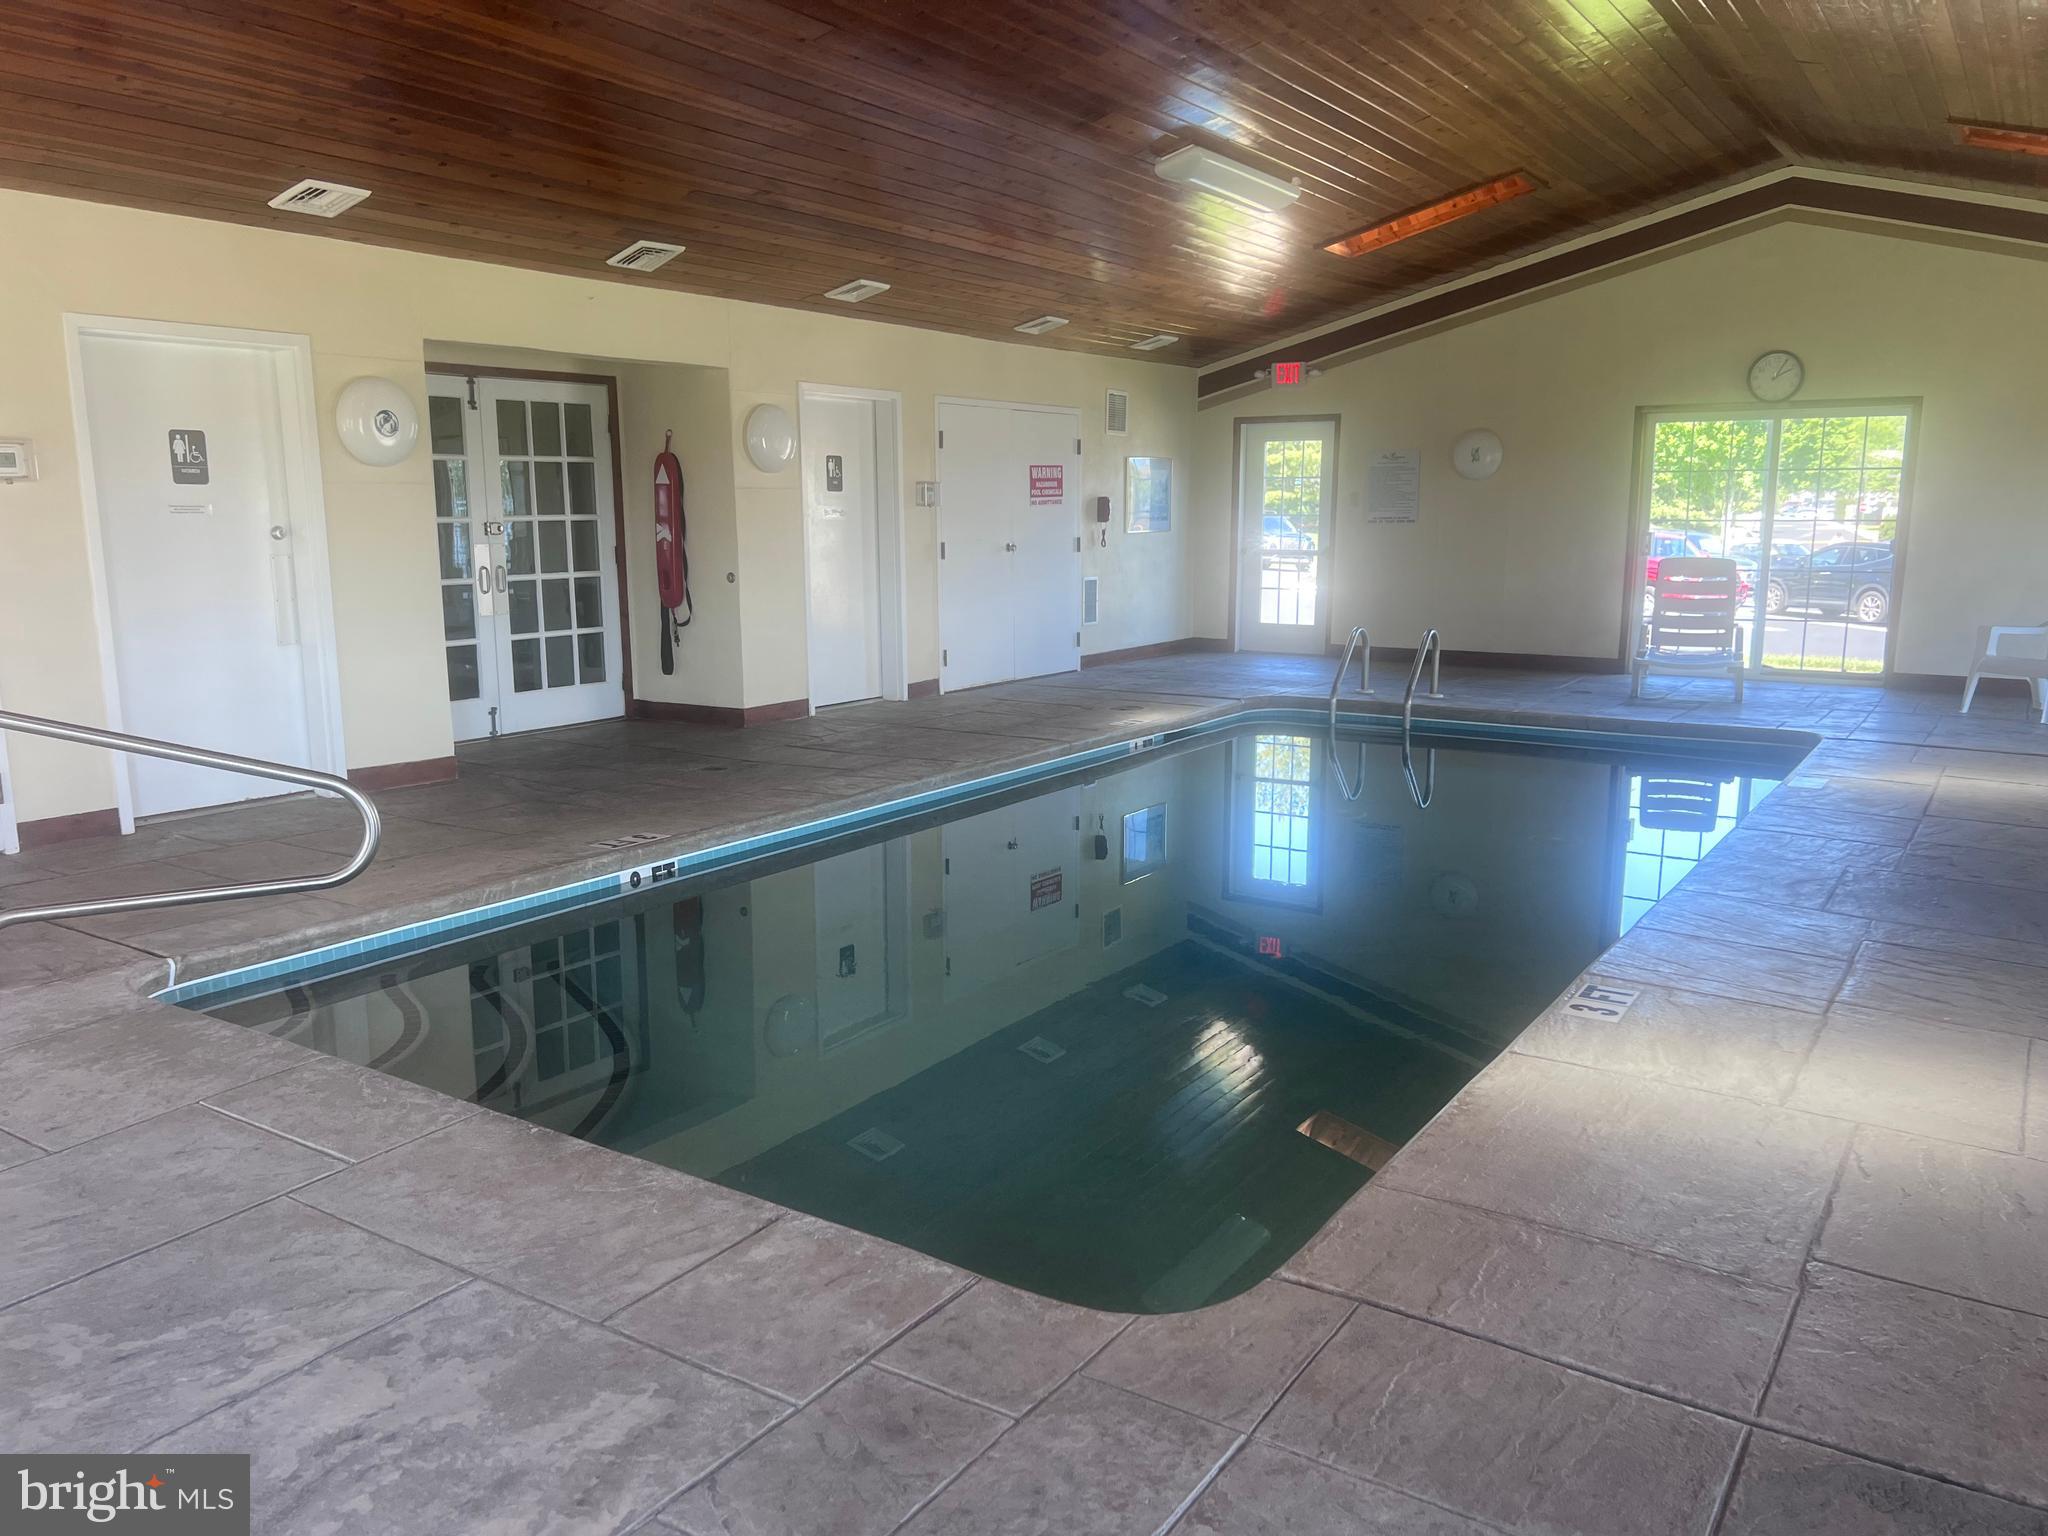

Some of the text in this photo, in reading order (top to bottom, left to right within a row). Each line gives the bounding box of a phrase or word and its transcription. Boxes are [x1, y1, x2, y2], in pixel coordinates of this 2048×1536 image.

[1276, 362, 1300, 384] EXIT
[1031, 467, 1062, 479] WARNING
[1569, 984, 1634, 1016] 3 FT
